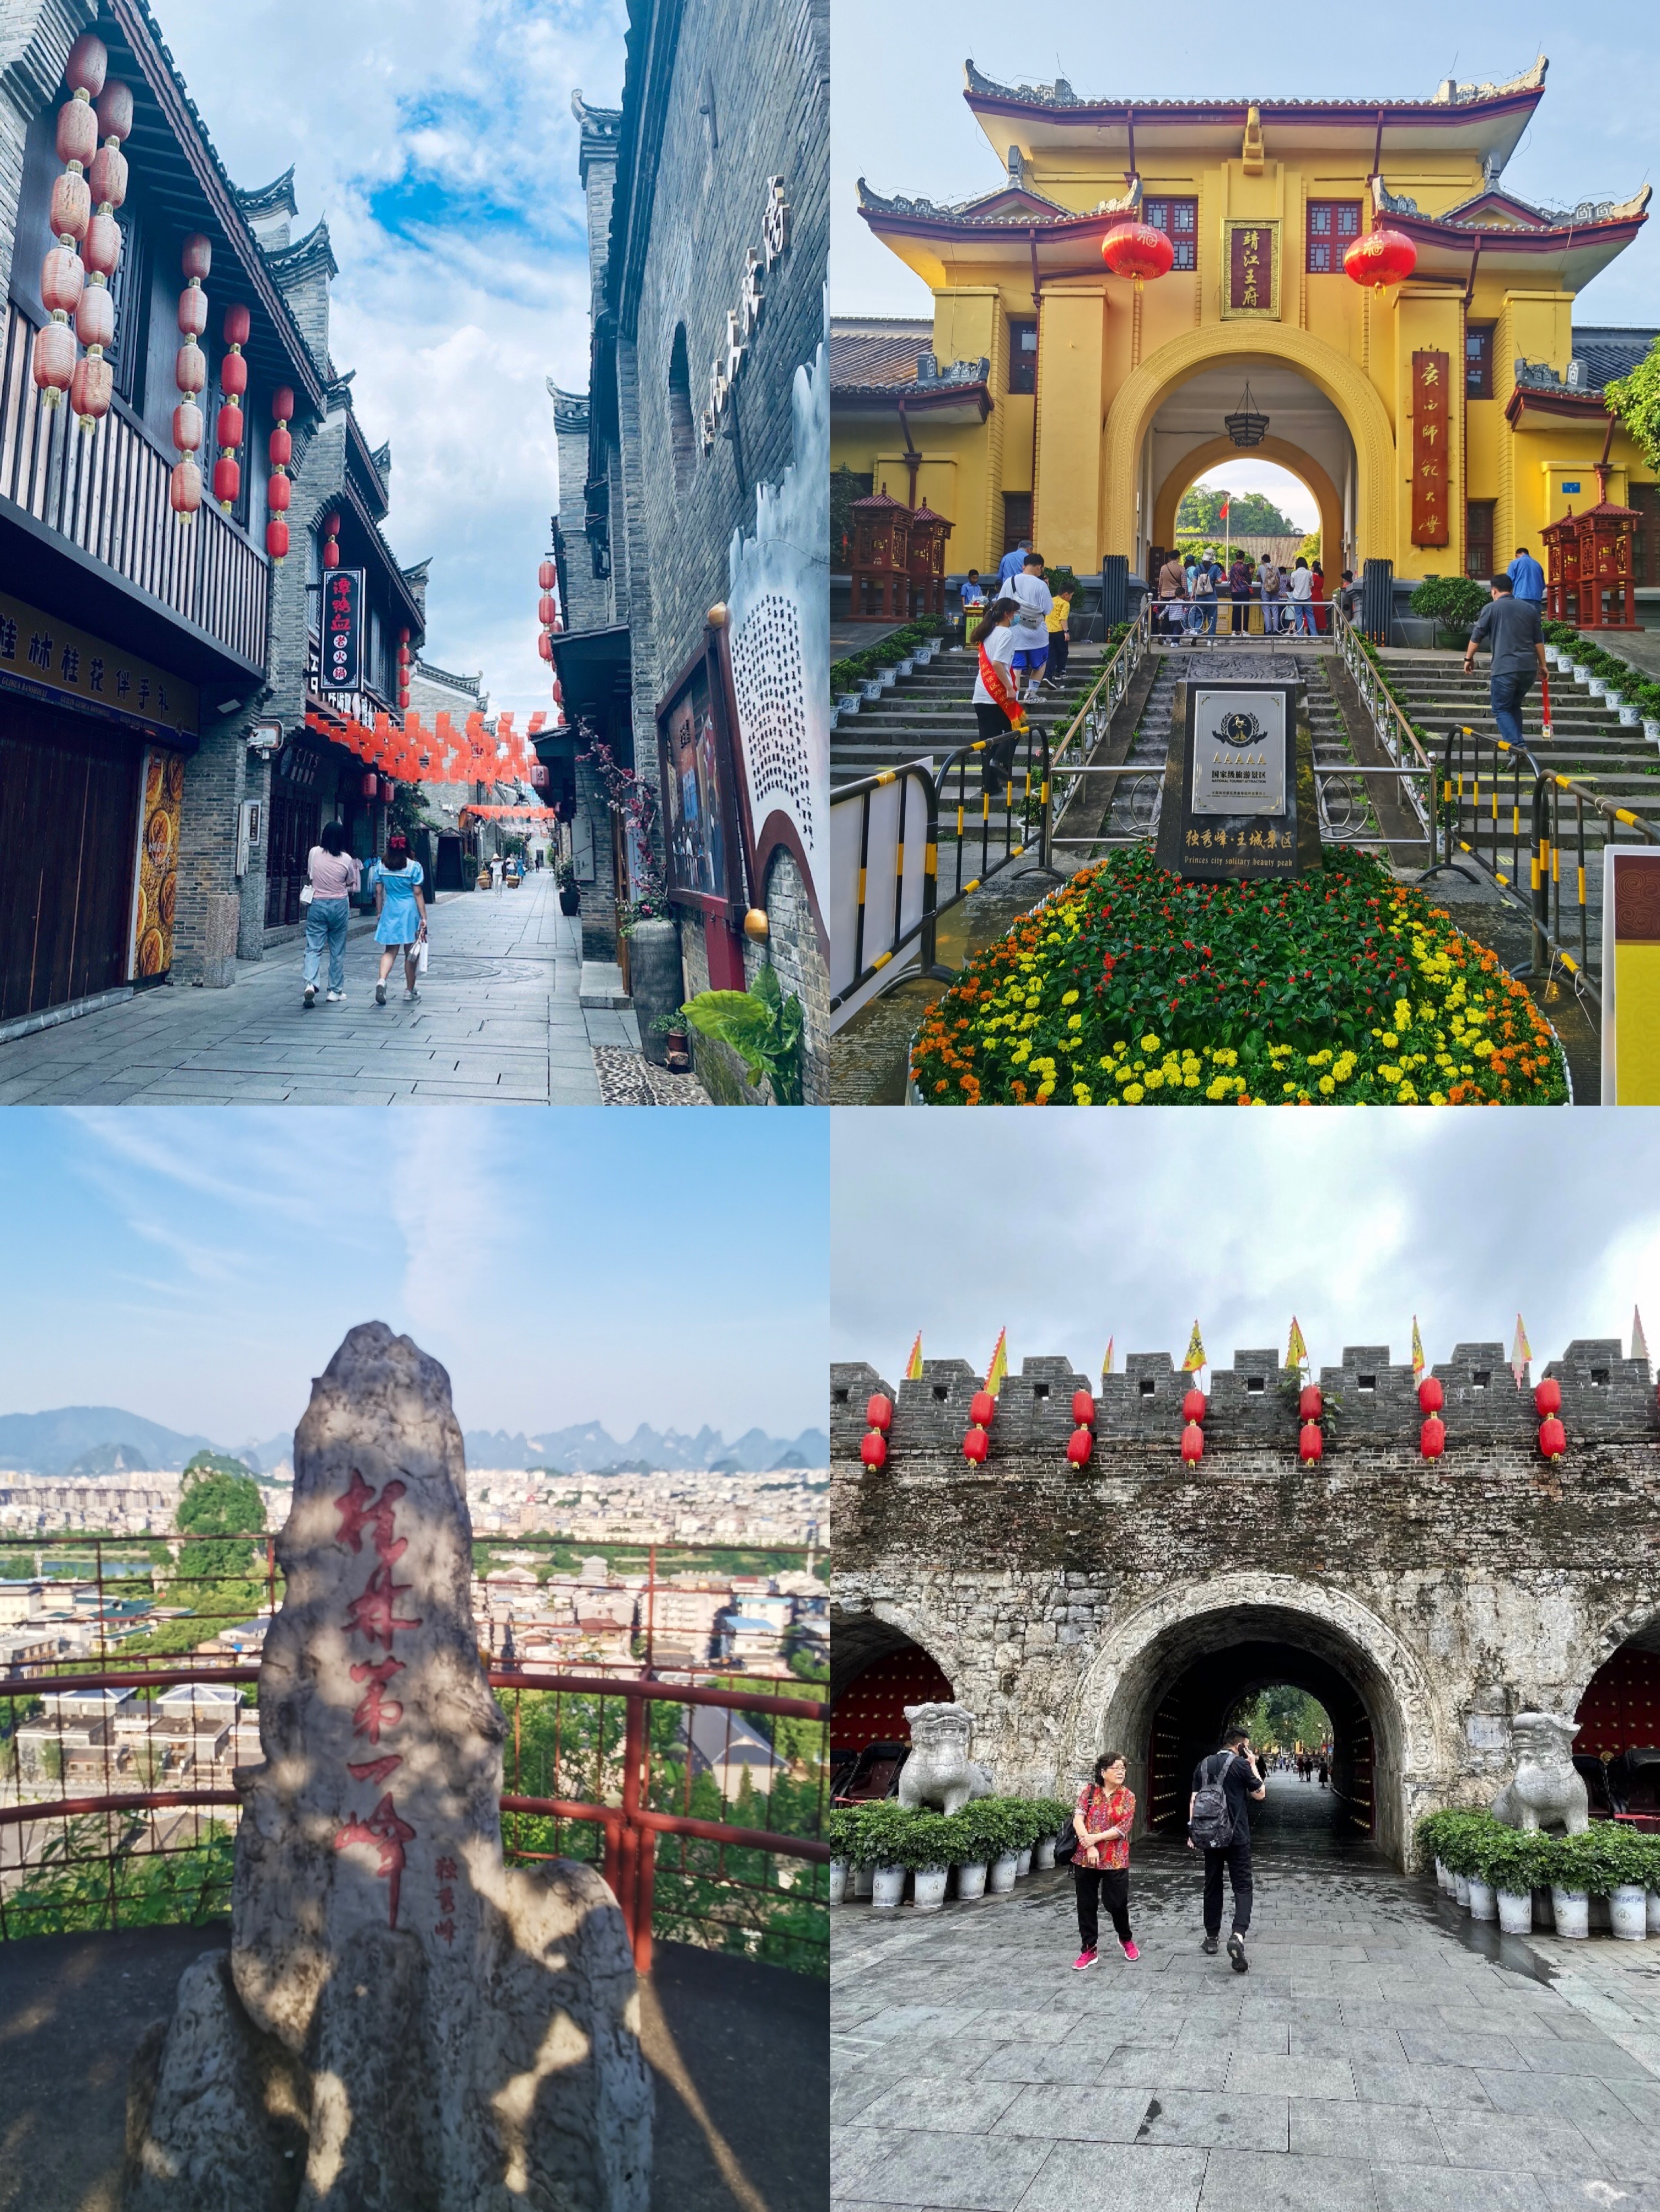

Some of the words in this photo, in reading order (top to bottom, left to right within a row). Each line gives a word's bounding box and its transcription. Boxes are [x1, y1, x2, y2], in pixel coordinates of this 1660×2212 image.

[1136, 226, 1158, 248] 福
[1242, 230, 1260, 307] 靖江王府
[0, 613, 169, 720] 桂林桂花伴手礼
[296, 749, 319, 768] CITS
[1212, 770, 1266, 779] 国家级旅游景区
[1185, 829, 1293, 849] 独秀峰·王城景区
[1185, 856, 1208, 864] Princes
[1211, 856, 1222, 866] city
[1225, 857, 1250, 867] solitary
[1253, 857, 1275, 867] beauty
[1277, 859, 1293, 867] peak
